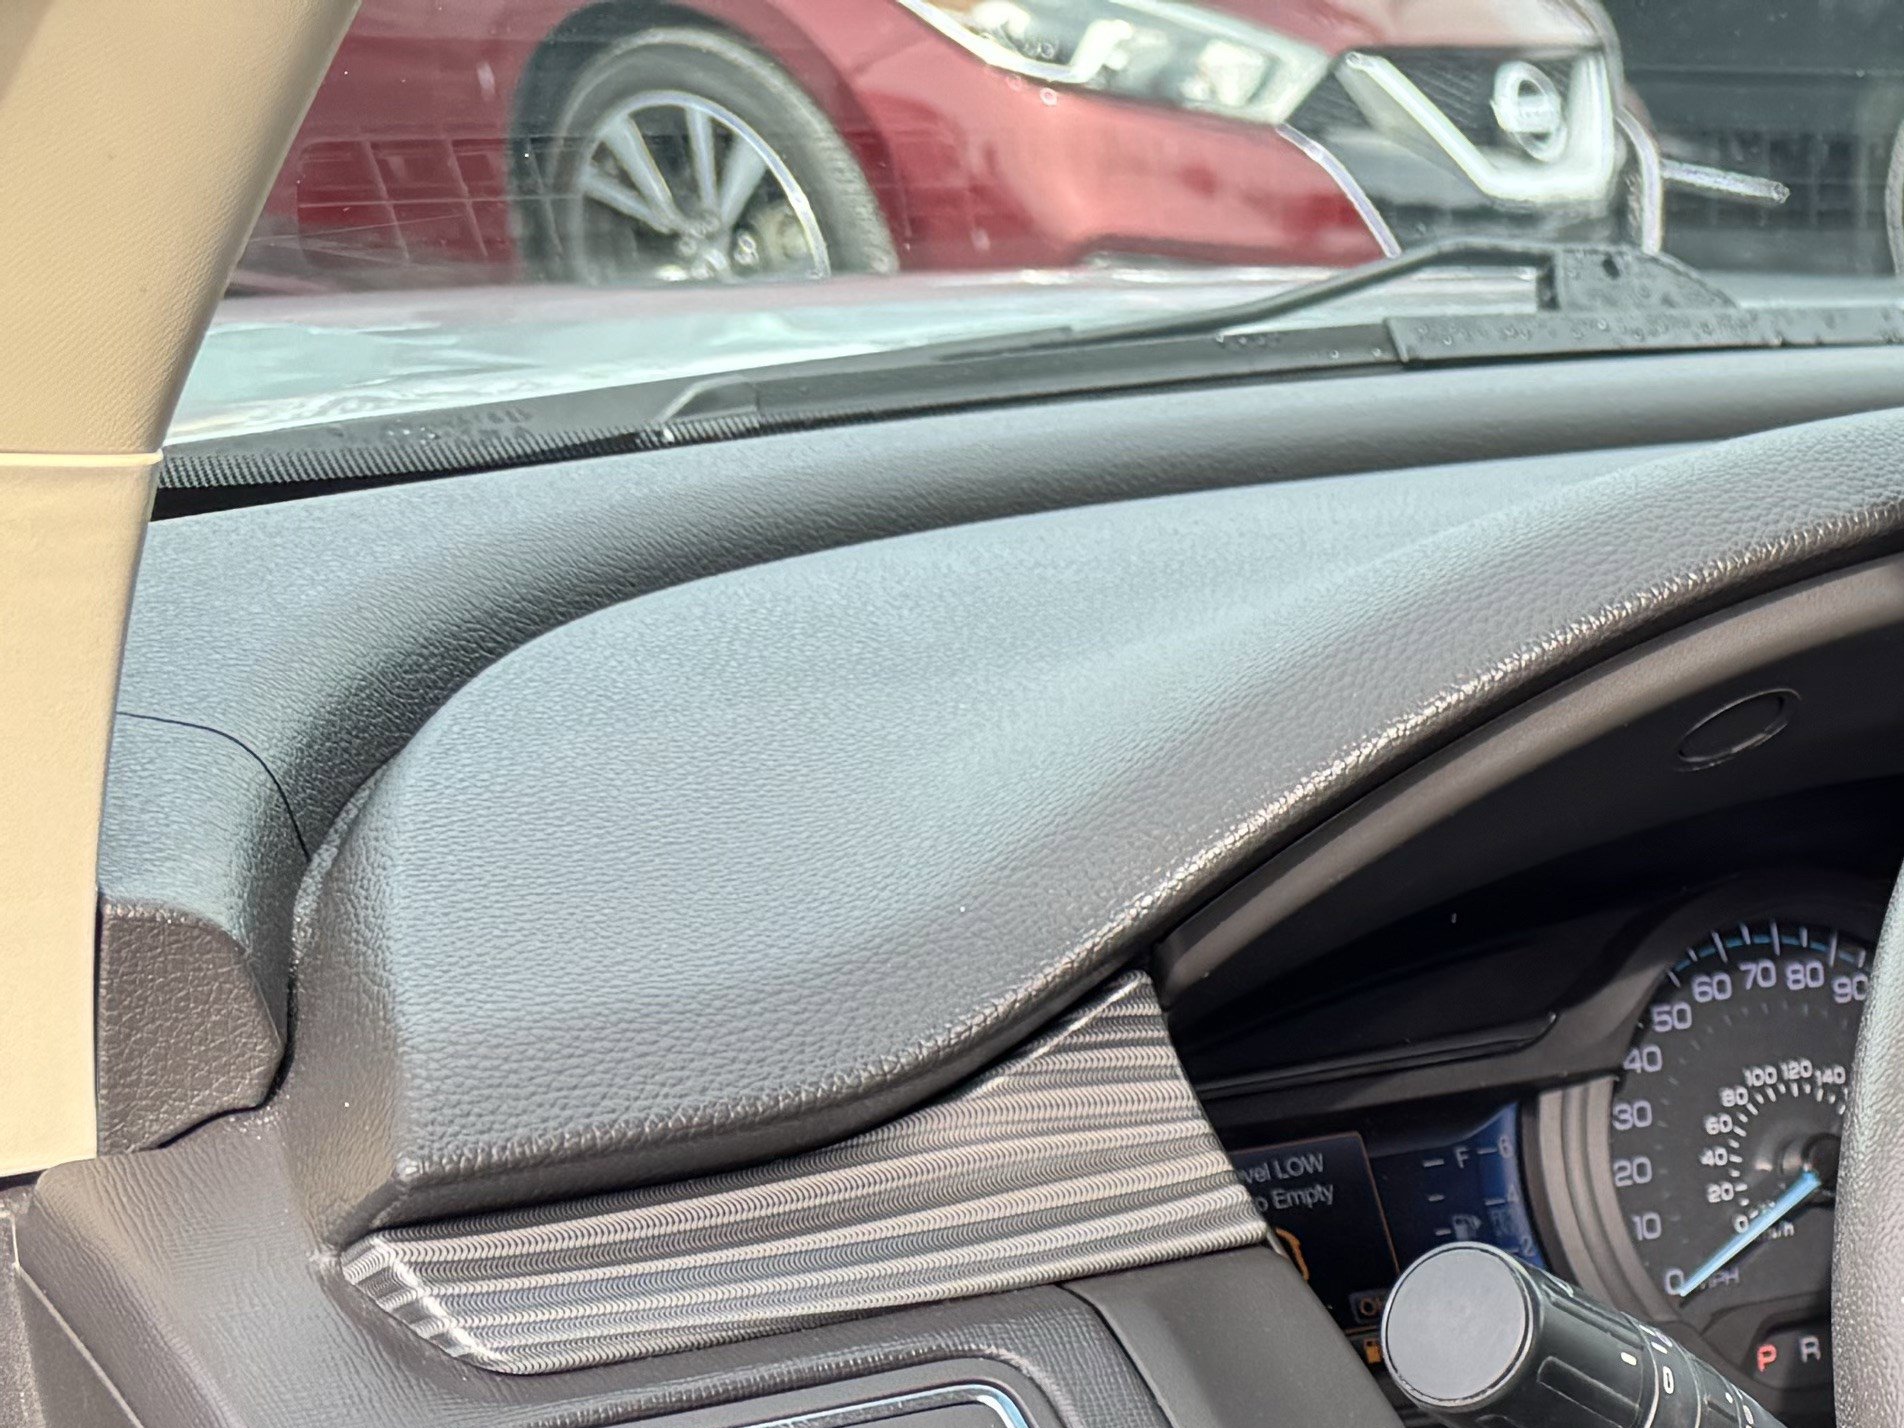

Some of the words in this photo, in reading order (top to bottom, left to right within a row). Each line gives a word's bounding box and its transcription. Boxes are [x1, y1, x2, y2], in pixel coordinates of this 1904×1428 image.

[1692, 973, 1732, 1002] 60
[1740, 959, 1777, 990] 70
[1786, 960, 1824, 990] 80
[1832, 974, 1869, 1003] 90
[1652, 1002, 1692, 1032] 50
[1623, 1044, 1662, 1074] 40
[1779, 1057, 1813, 1081] 120
[1743, 1065, 1777, 1087] 100
[1815, 1064, 1846, 1085] 140
[1720, 1085, 1749, 1107] 80
[1612, 1100, 1652, 1130] 30
[1704, 1113, 1732, 1135] 60
[1244, 1161, 1271, 1184] vel
[1274, 1152, 1324, 1181] LOW
[1455, 1147, 1470, 1169] F
[1613, 1156, 1652, 1187] 20
[1700, 1147, 1728, 1167] 40
[1274, 1182, 1334, 1212] Empty
[1707, 1181, 1734, 1203] 20
[1632, 1212, 1662, 1241] 10
[1664, 1268, 1685, 1296] 0
[1757, 1344, 1777, 1372] P
[1801, 1335, 1822, 1363] R
